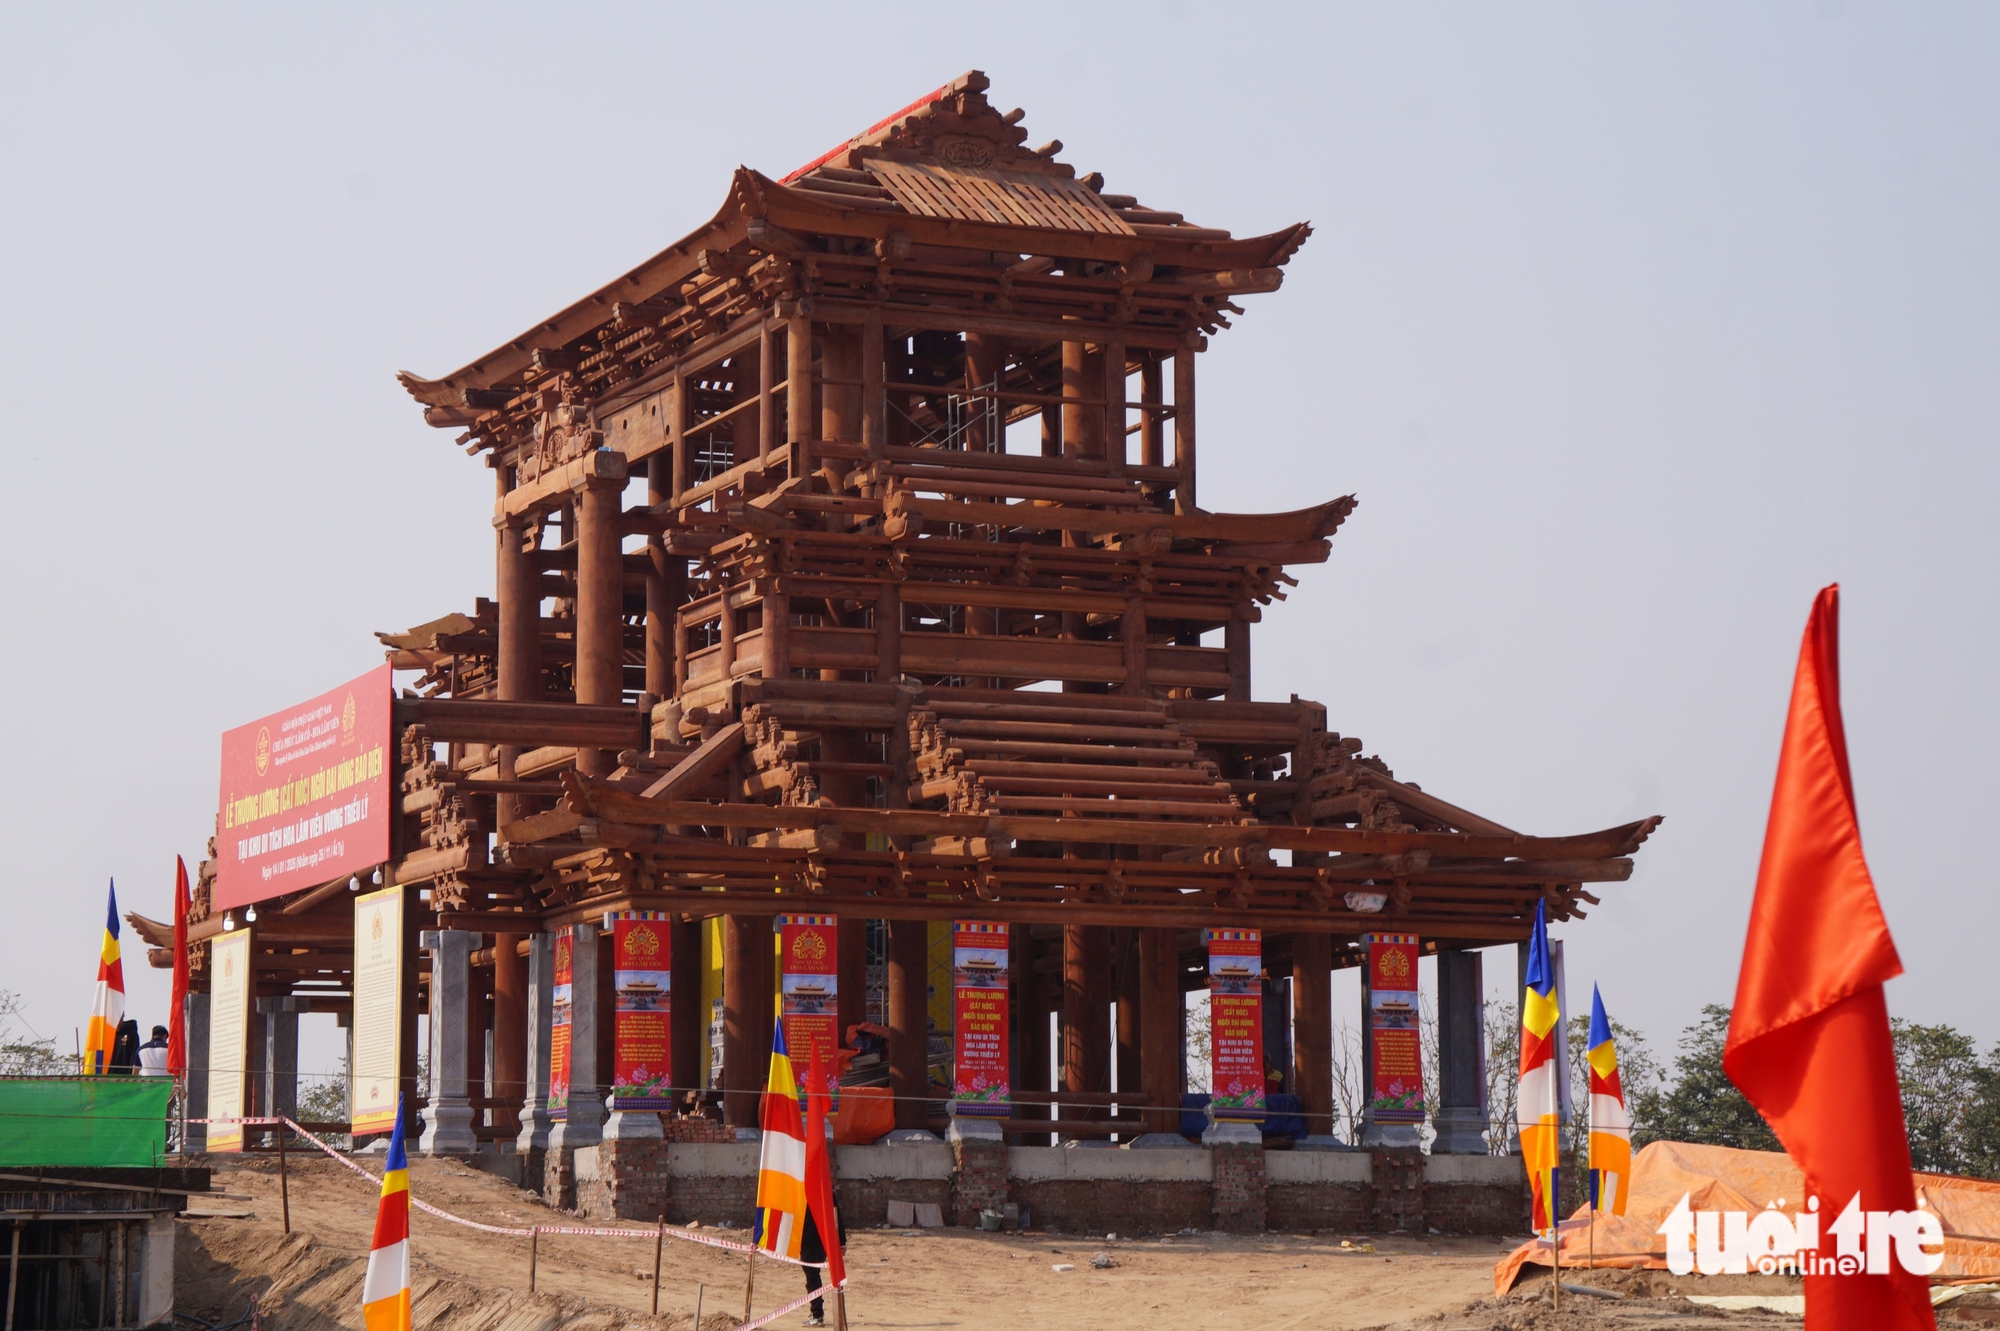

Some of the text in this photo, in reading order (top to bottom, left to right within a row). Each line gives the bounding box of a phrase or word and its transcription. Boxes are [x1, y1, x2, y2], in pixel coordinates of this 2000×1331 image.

[226, 742, 382, 830] LỄ THƯỢNG LƯƠNG (CẤT NÓC) NGÔI ĐẠI HÙNG BẢO ĐIỆN
[238, 792, 369, 864] TẠI KHU DI TÍCH HOA LÂM VIÊN VƯƠNG TRIỀU LÝ
[262, 864, 272, 881] Ngày
[286, 857, 296, 872] 2026
[309, 850, 318, 868] ngày
[958, 989, 1005, 1002] LỄ THƯỢNG LƯƠNG
[970, 1000, 995, 1011] (CẤT NÓC)
[1213, 996, 1219, 1005] LỄ
[1220, 998, 1240, 1007] THƯỢNG
[963, 1011, 1001, 1021] NGÔI ĐẠI HÙNG
[1224, 1007, 1248, 1017] (CẤT NÓC)
[970, 1021, 994, 1032] BẢO ĐIỆN
[1217, 1018, 1230, 1026] NGÔI
[1231, 1019, 1239, 1028] ĐẠI
[1225, 1026, 1248, 1038] BẢO ĐIỆN
[964, 1034, 972, 1042] TẠI
[980, 1050, 994, 1058] TRIỀU
[1236, 1055, 1248, 1063] TRIỀU
